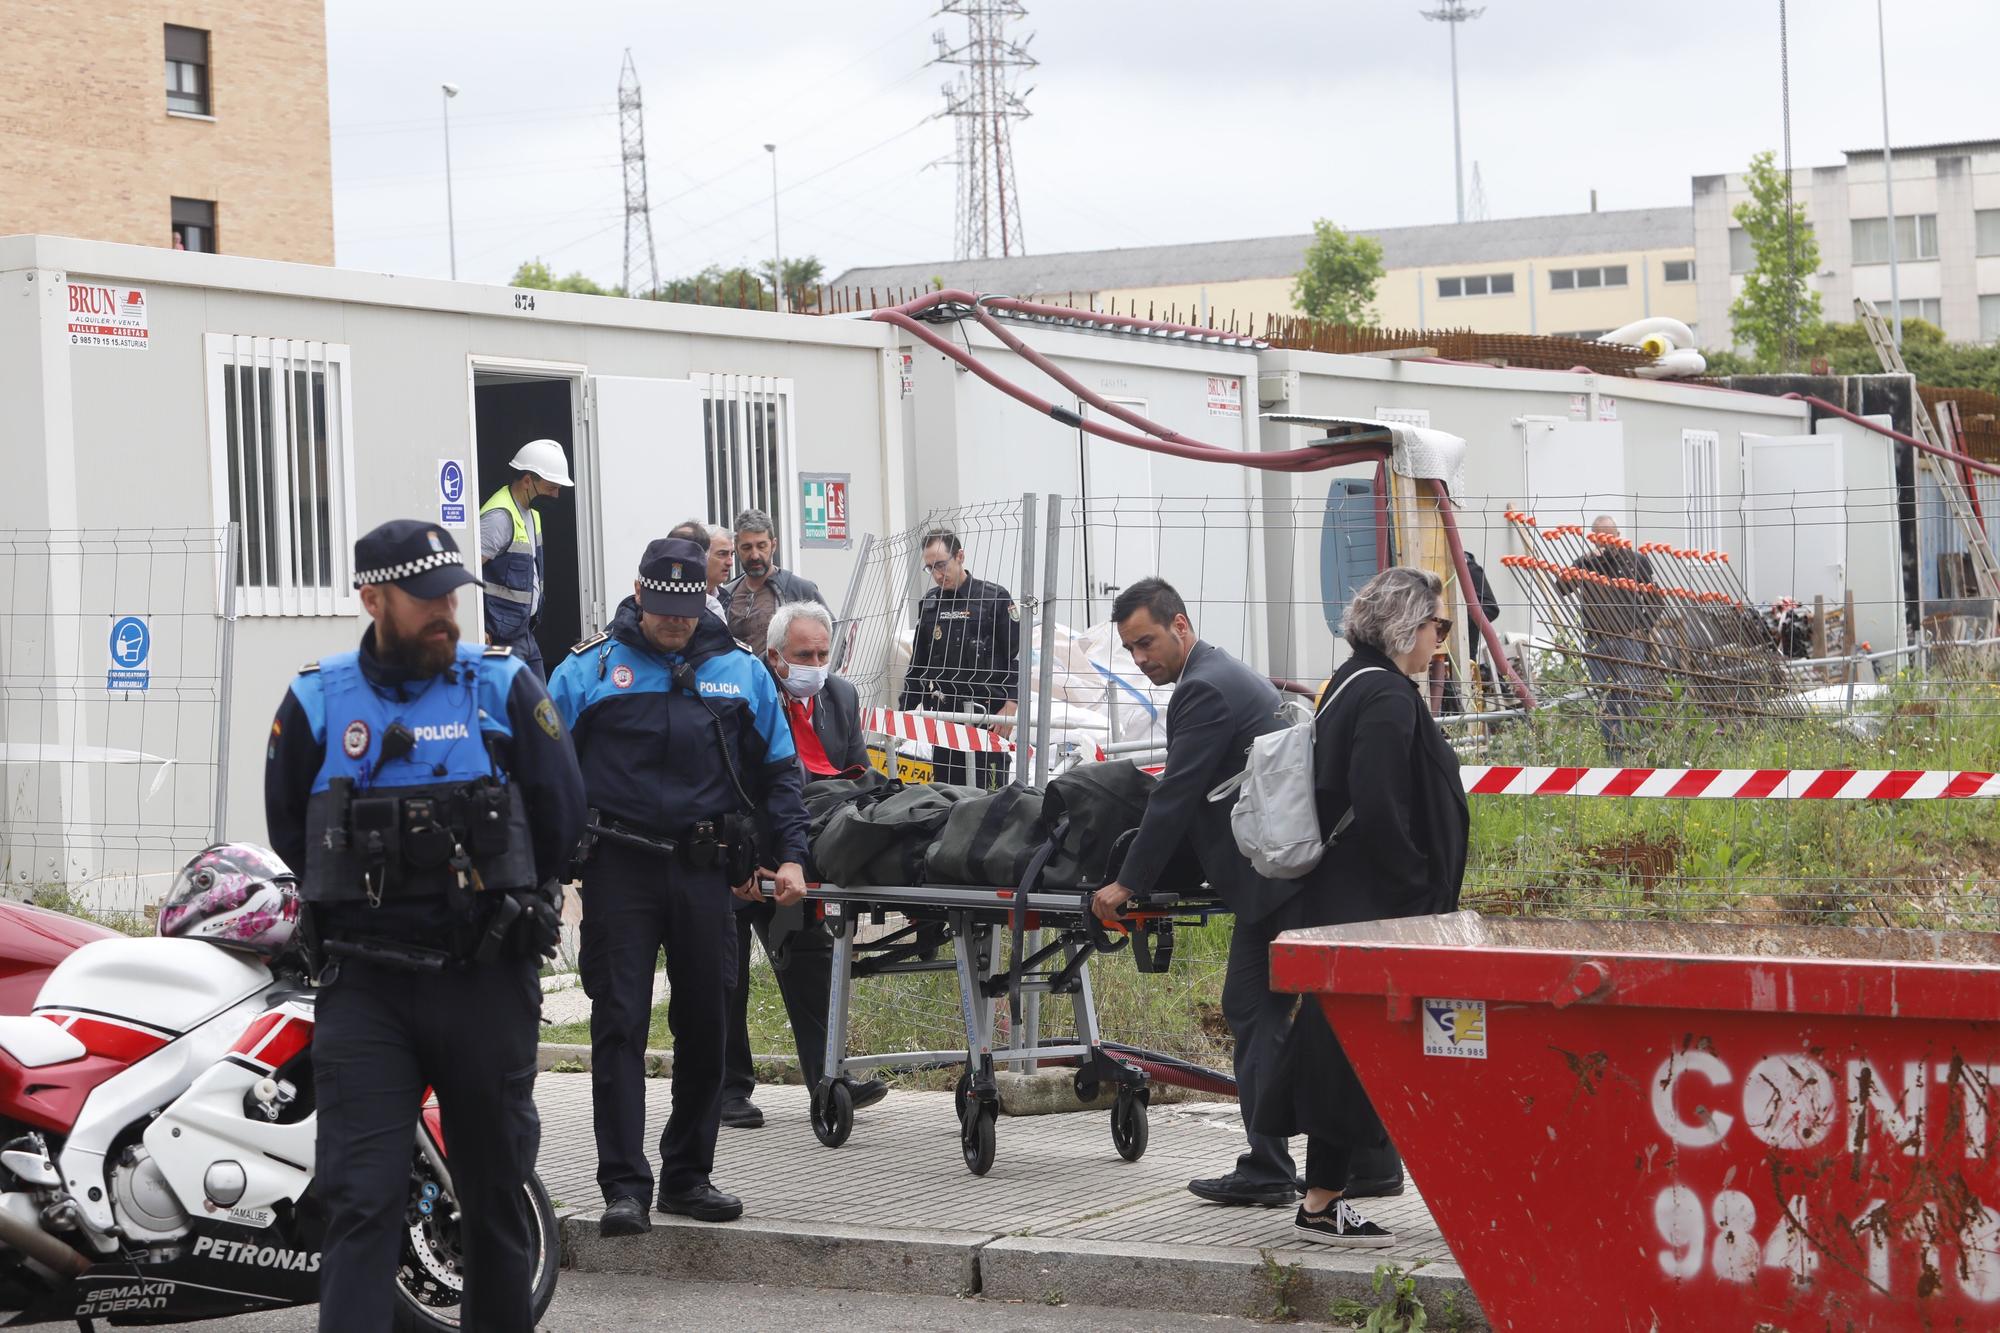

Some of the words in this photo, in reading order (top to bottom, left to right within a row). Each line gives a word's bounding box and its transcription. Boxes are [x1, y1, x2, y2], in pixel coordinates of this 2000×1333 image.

[68, 285, 116, 315] BRUN
[515, 293, 535, 310] 874
[75, 316, 110, 324] ALQUILER
[71, 325, 100, 333] VALLAS
[112, 328, 145, 337] CASETAS
[79, 336, 92, 344] 985
[93, 337, 101, 345] 79
[700, 681, 740, 695] POLICÍA
[414, 721, 469, 741] POLICÍA
[1425, 1000, 1483, 1009] SYESVE
[1426, 1045, 1443, 1053] 985
[1447, 1046, 1464, 1055] 575
[1467, 1048, 1484, 1056] 985
[231, 1207, 268, 1221] YAMALUBE
[193, 1236, 321, 1272] PETRONAS
[75, 1303, 96, 1315] DI
